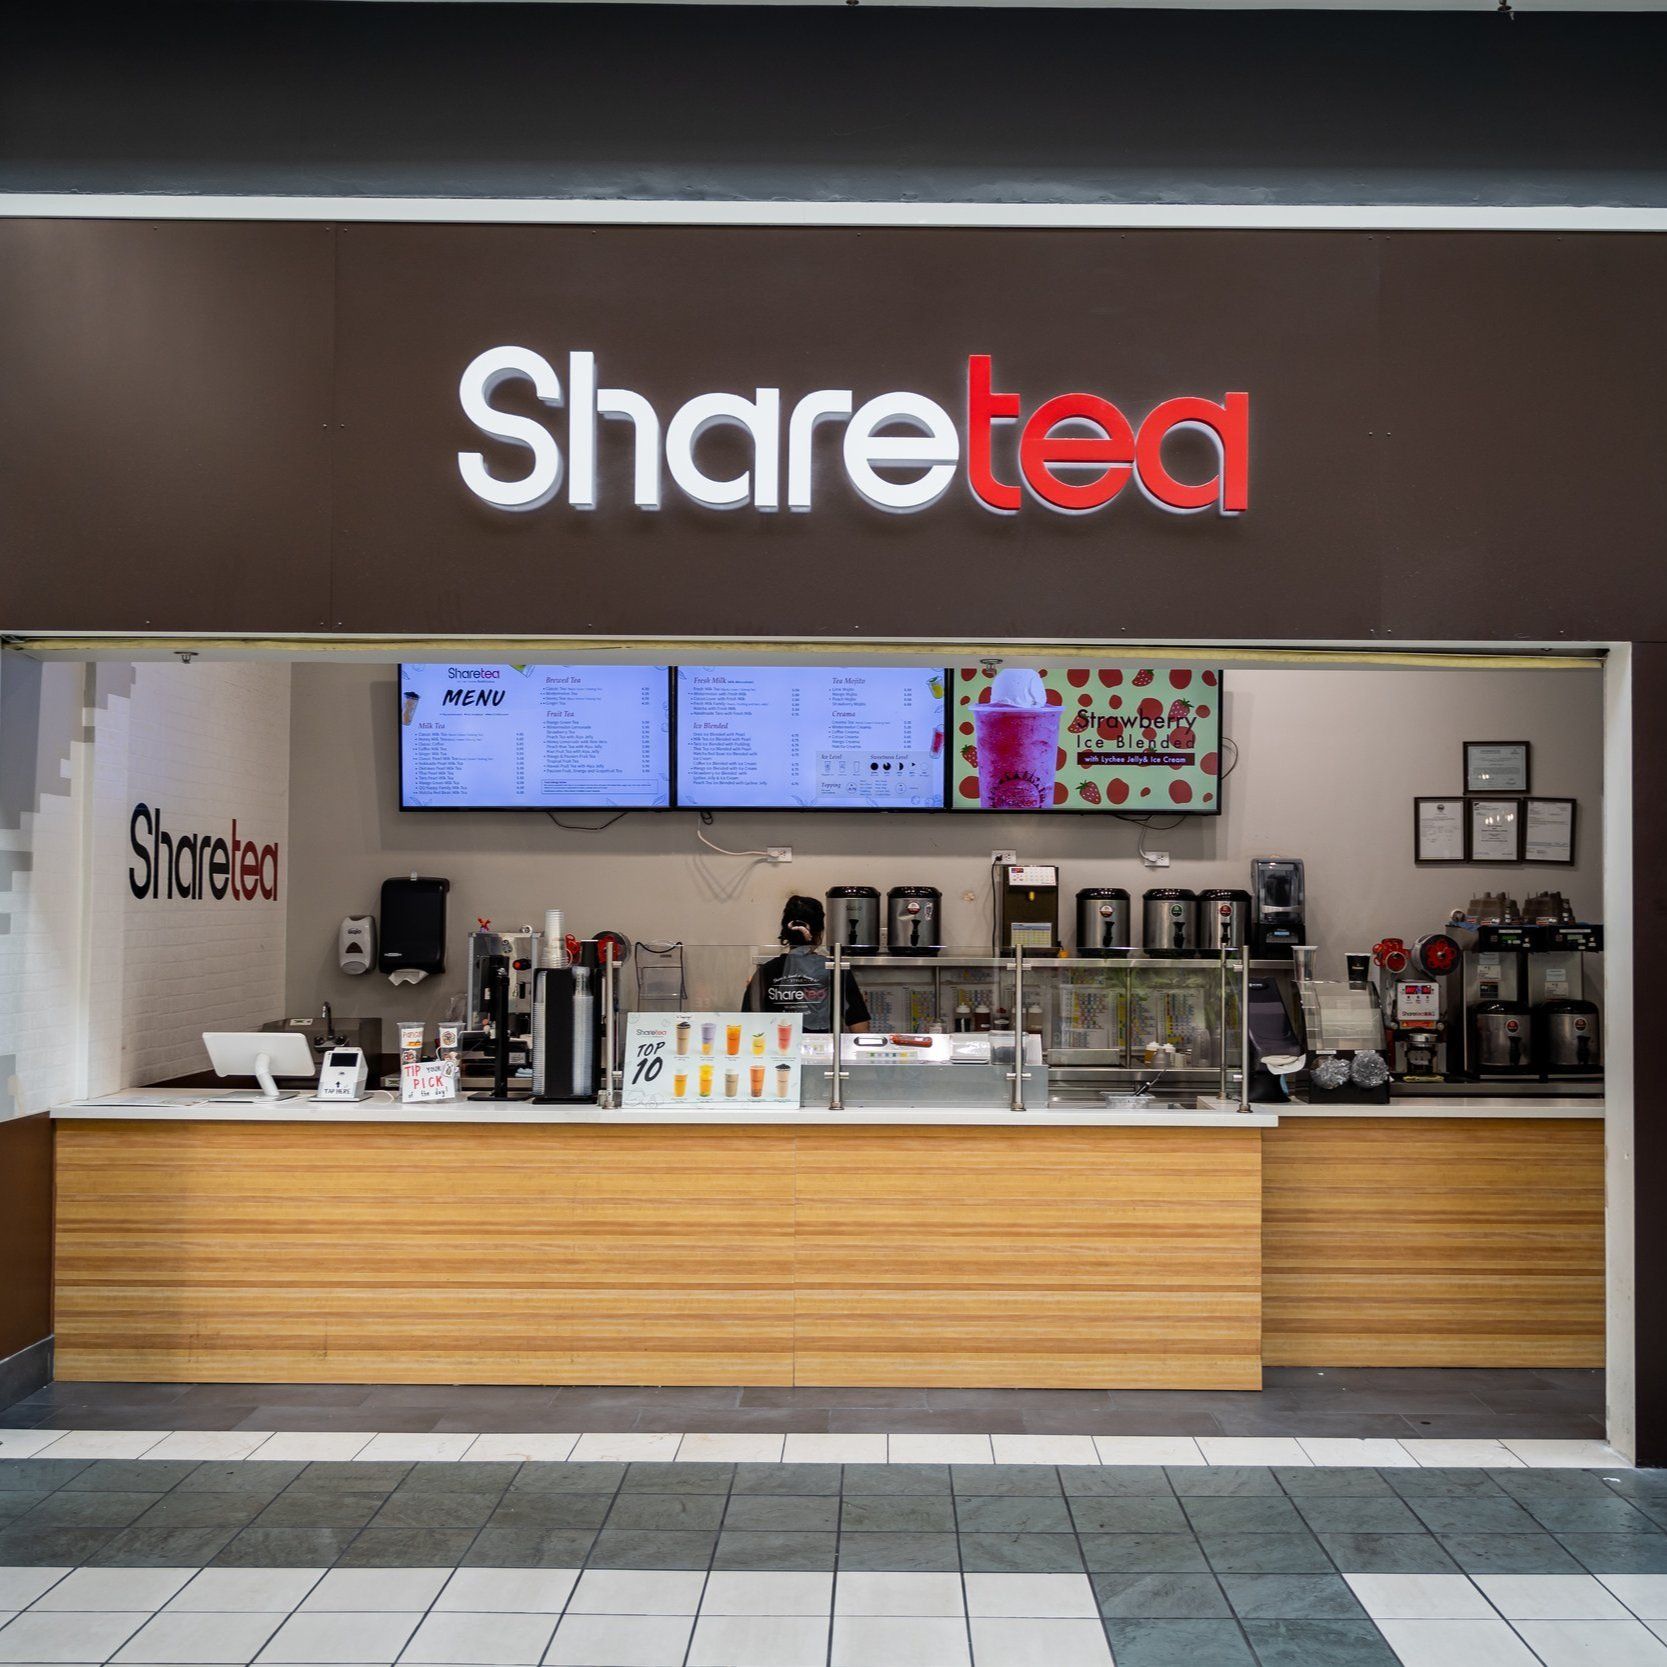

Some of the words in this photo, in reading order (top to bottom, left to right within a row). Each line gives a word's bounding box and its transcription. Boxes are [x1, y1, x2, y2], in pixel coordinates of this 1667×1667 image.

[457, 344, 1250, 518] Sharetea
[447, 667, 500, 679] Sharetea
[442, 688, 506, 707] MENU
[1076, 708, 1197, 734] Strawberry
[1076, 735, 1105, 749] Ice
[1116, 734, 1195, 749] Blended
[1084, 755, 1099, 764] with
[1101, 755, 1125, 765] Lychee
[1127, 755, 1148, 765] Jelly&
[1150, 755, 1161, 764] Ice
[1163, 755, 1186, 764] Cream
[821, 782, 841, 790] Topping
[128, 802, 279, 902] Sharetea
[635, 1028, 667, 1036] Sharetea
[636, 1041, 666, 1058] TOP
[404, 1064, 421, 1077] TIP
[426, 1065, 441, 1073] YOUR
[631, 1056, 664, 1085] 10
[413, 1075, 444, 1090] PICK
[420, 1089, 430, 1097] the
